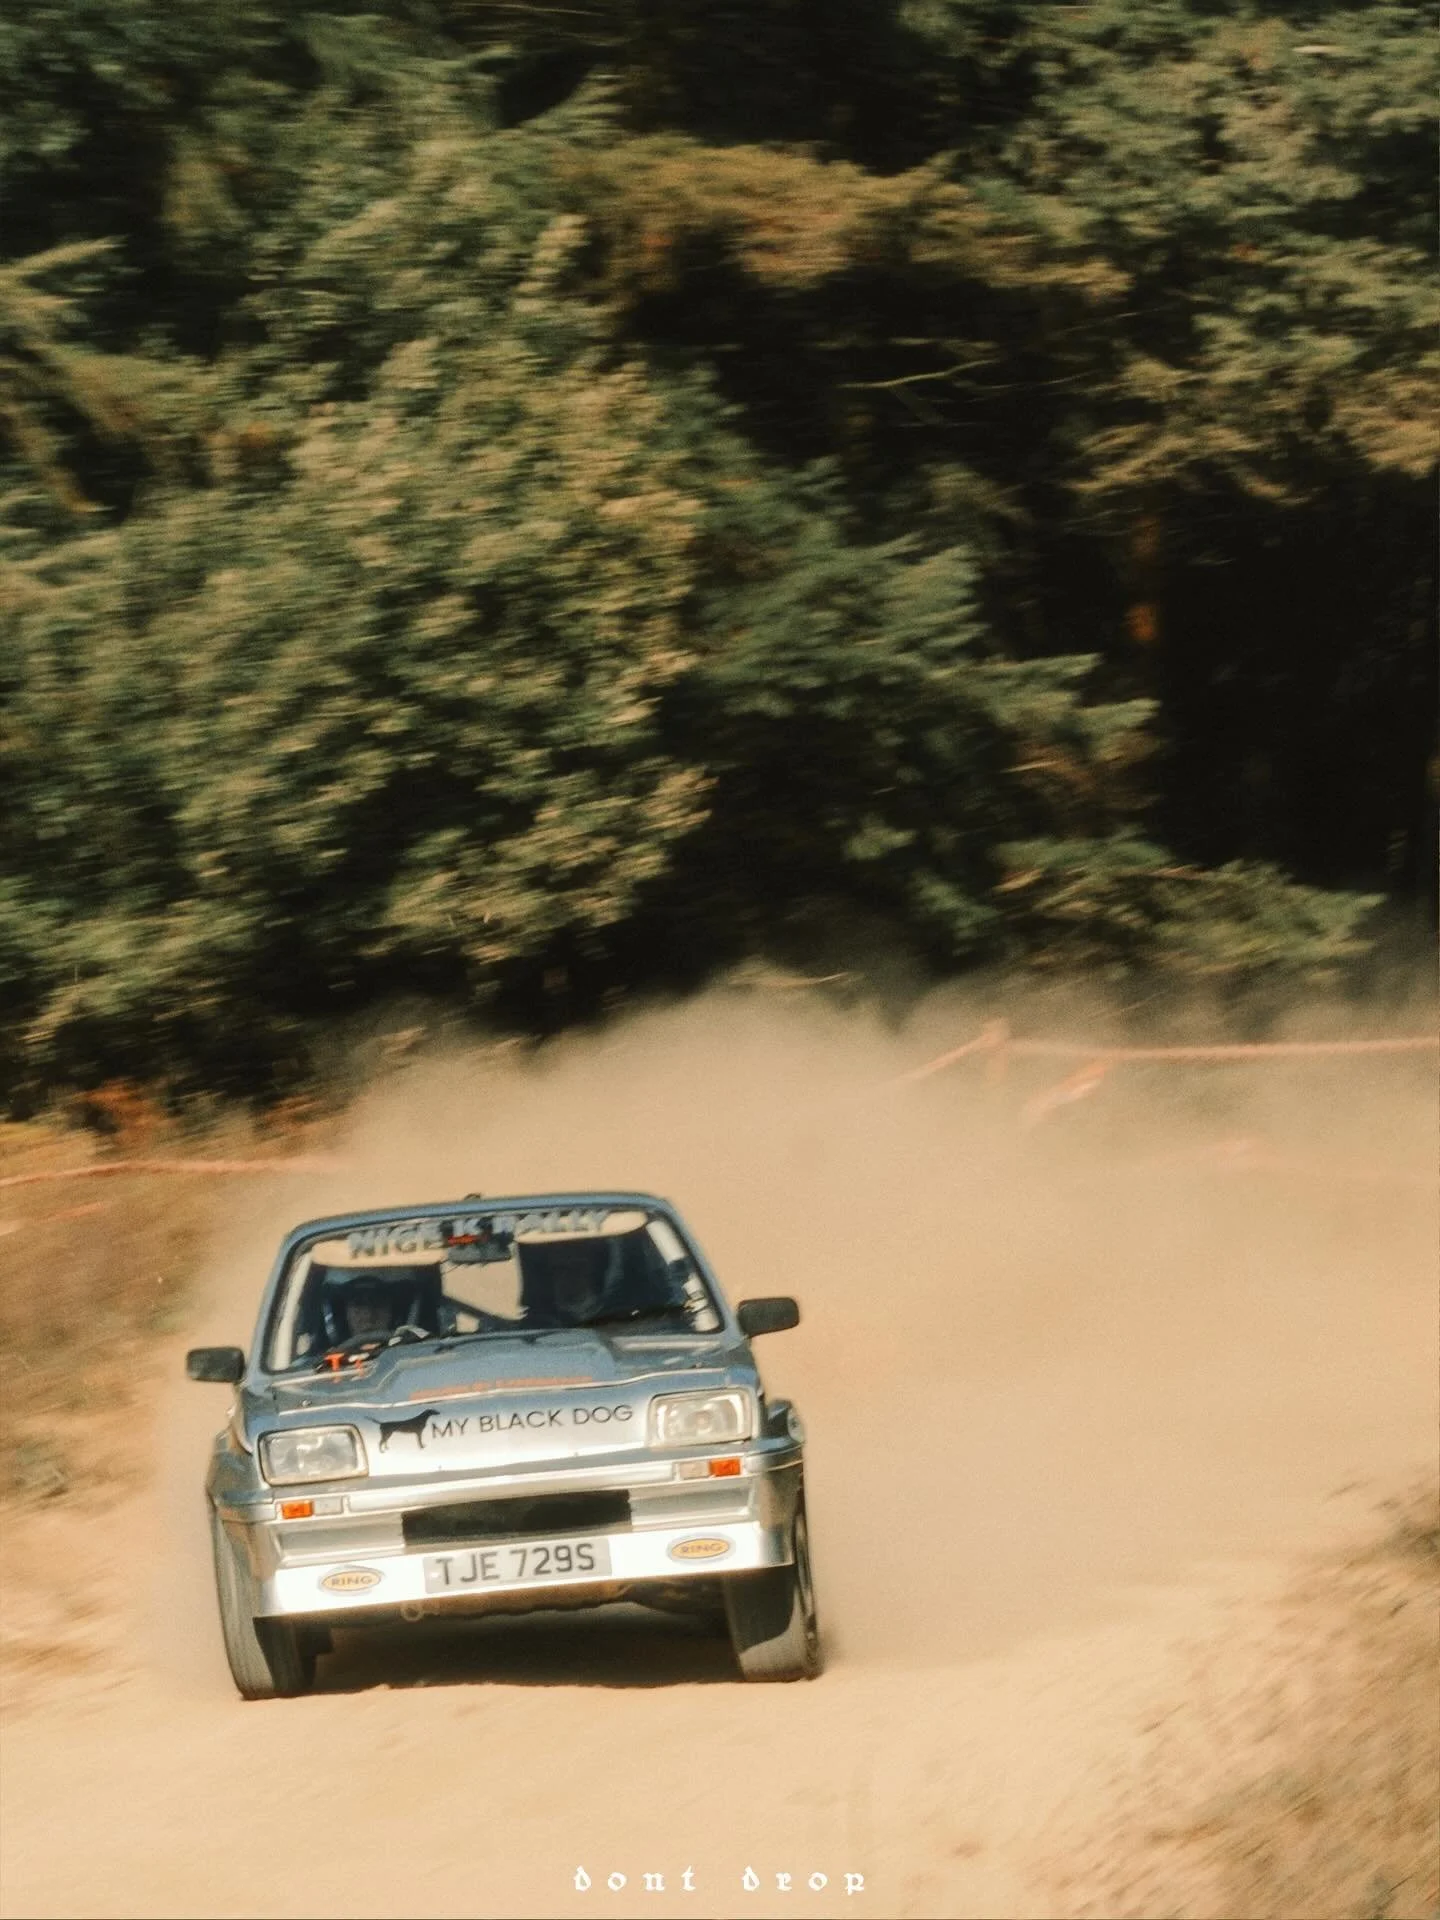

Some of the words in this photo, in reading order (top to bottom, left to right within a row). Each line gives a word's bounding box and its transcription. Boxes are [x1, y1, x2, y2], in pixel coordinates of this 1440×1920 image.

[431, 1417, 469, 1440] MY
[479, 1408, 563, 1434] BLACK
[573, 1403, 634, 1426] DOG
[681, 1542, 724, 1555] RING
[436, 1551, 500, 1586] TJE
[509, 1542, 596, 1578] 729S
[331, 1574, 374, 1587] RING
